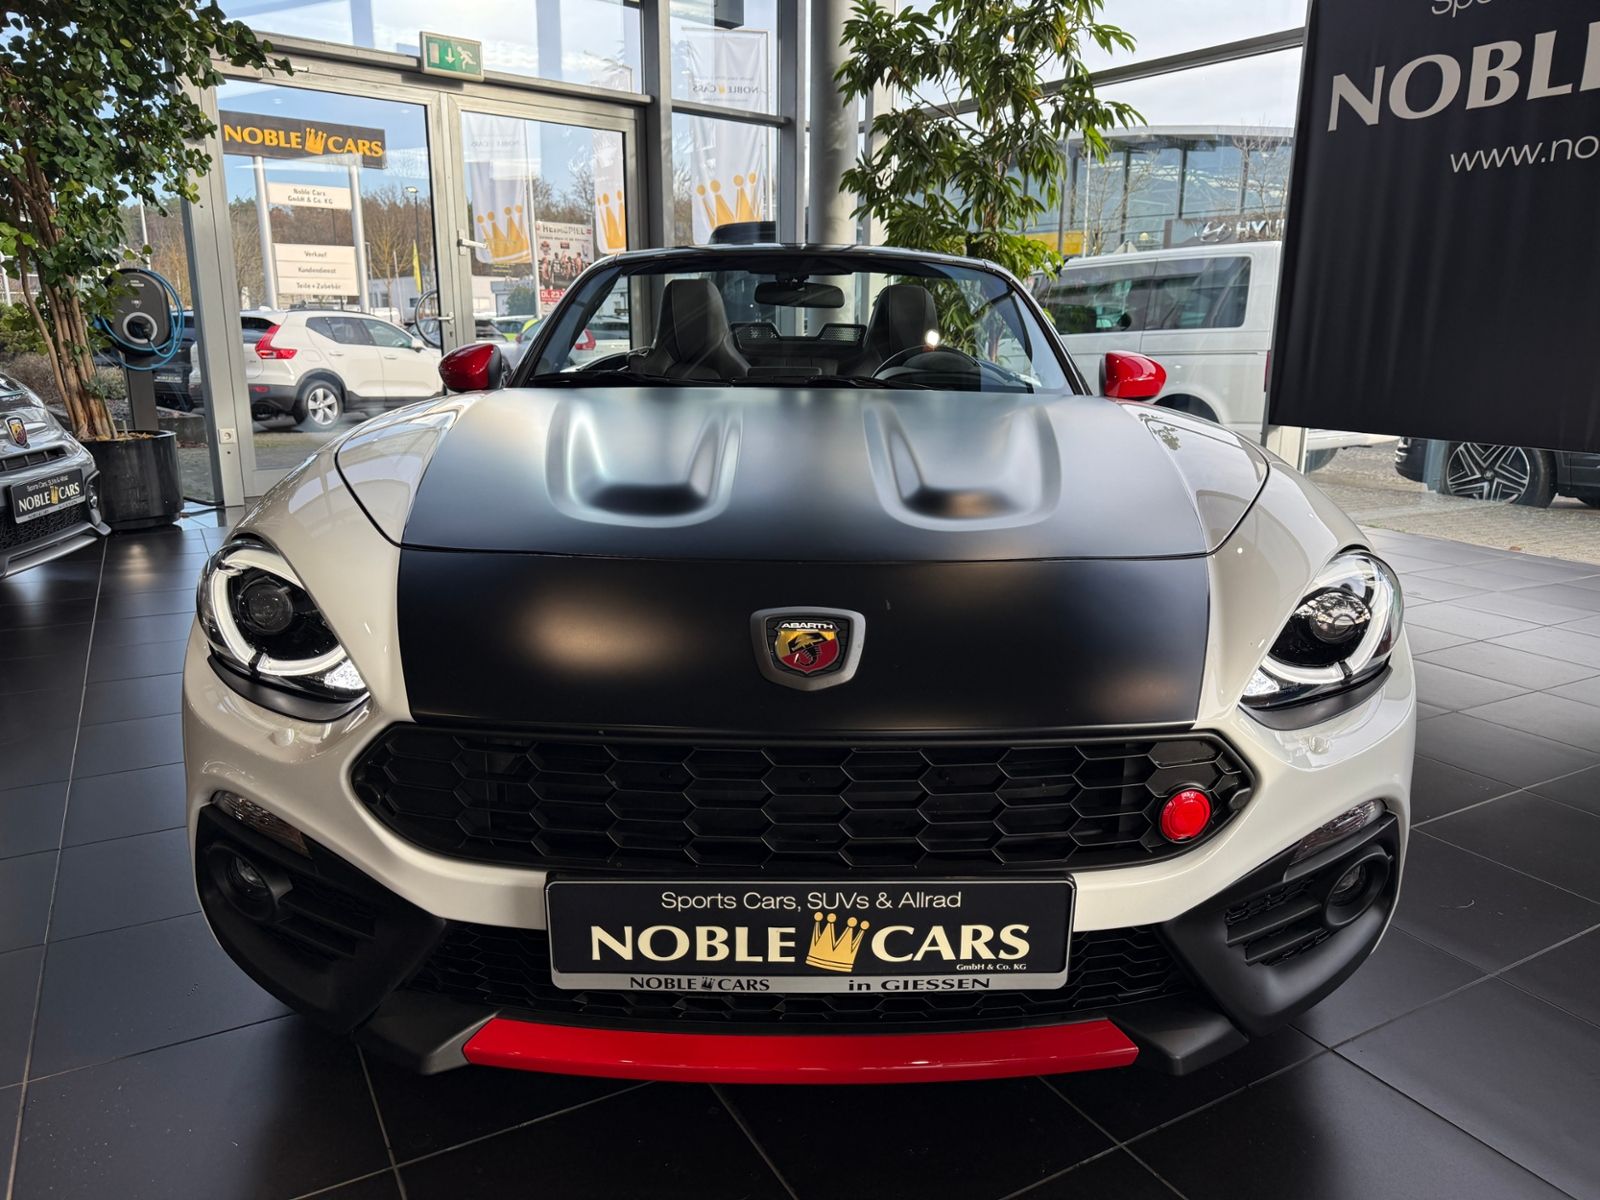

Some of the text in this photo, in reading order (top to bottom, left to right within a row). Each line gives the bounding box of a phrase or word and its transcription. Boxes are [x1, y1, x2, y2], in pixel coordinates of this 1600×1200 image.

[223, 124, 384, 157] NOBLE CARS
[18, 491, 50, 512] NOBLE
[58, 482, 80, 499] CARS
[661, 891, 962, 912] Sports Cars, SUVs & Allrad
[590, 924, 1030, 963] NOBLE CARS
[956, 963, 985, 971] GmbH
[630, 976, 990, 991] NOBLE CARS in GIESSEN
